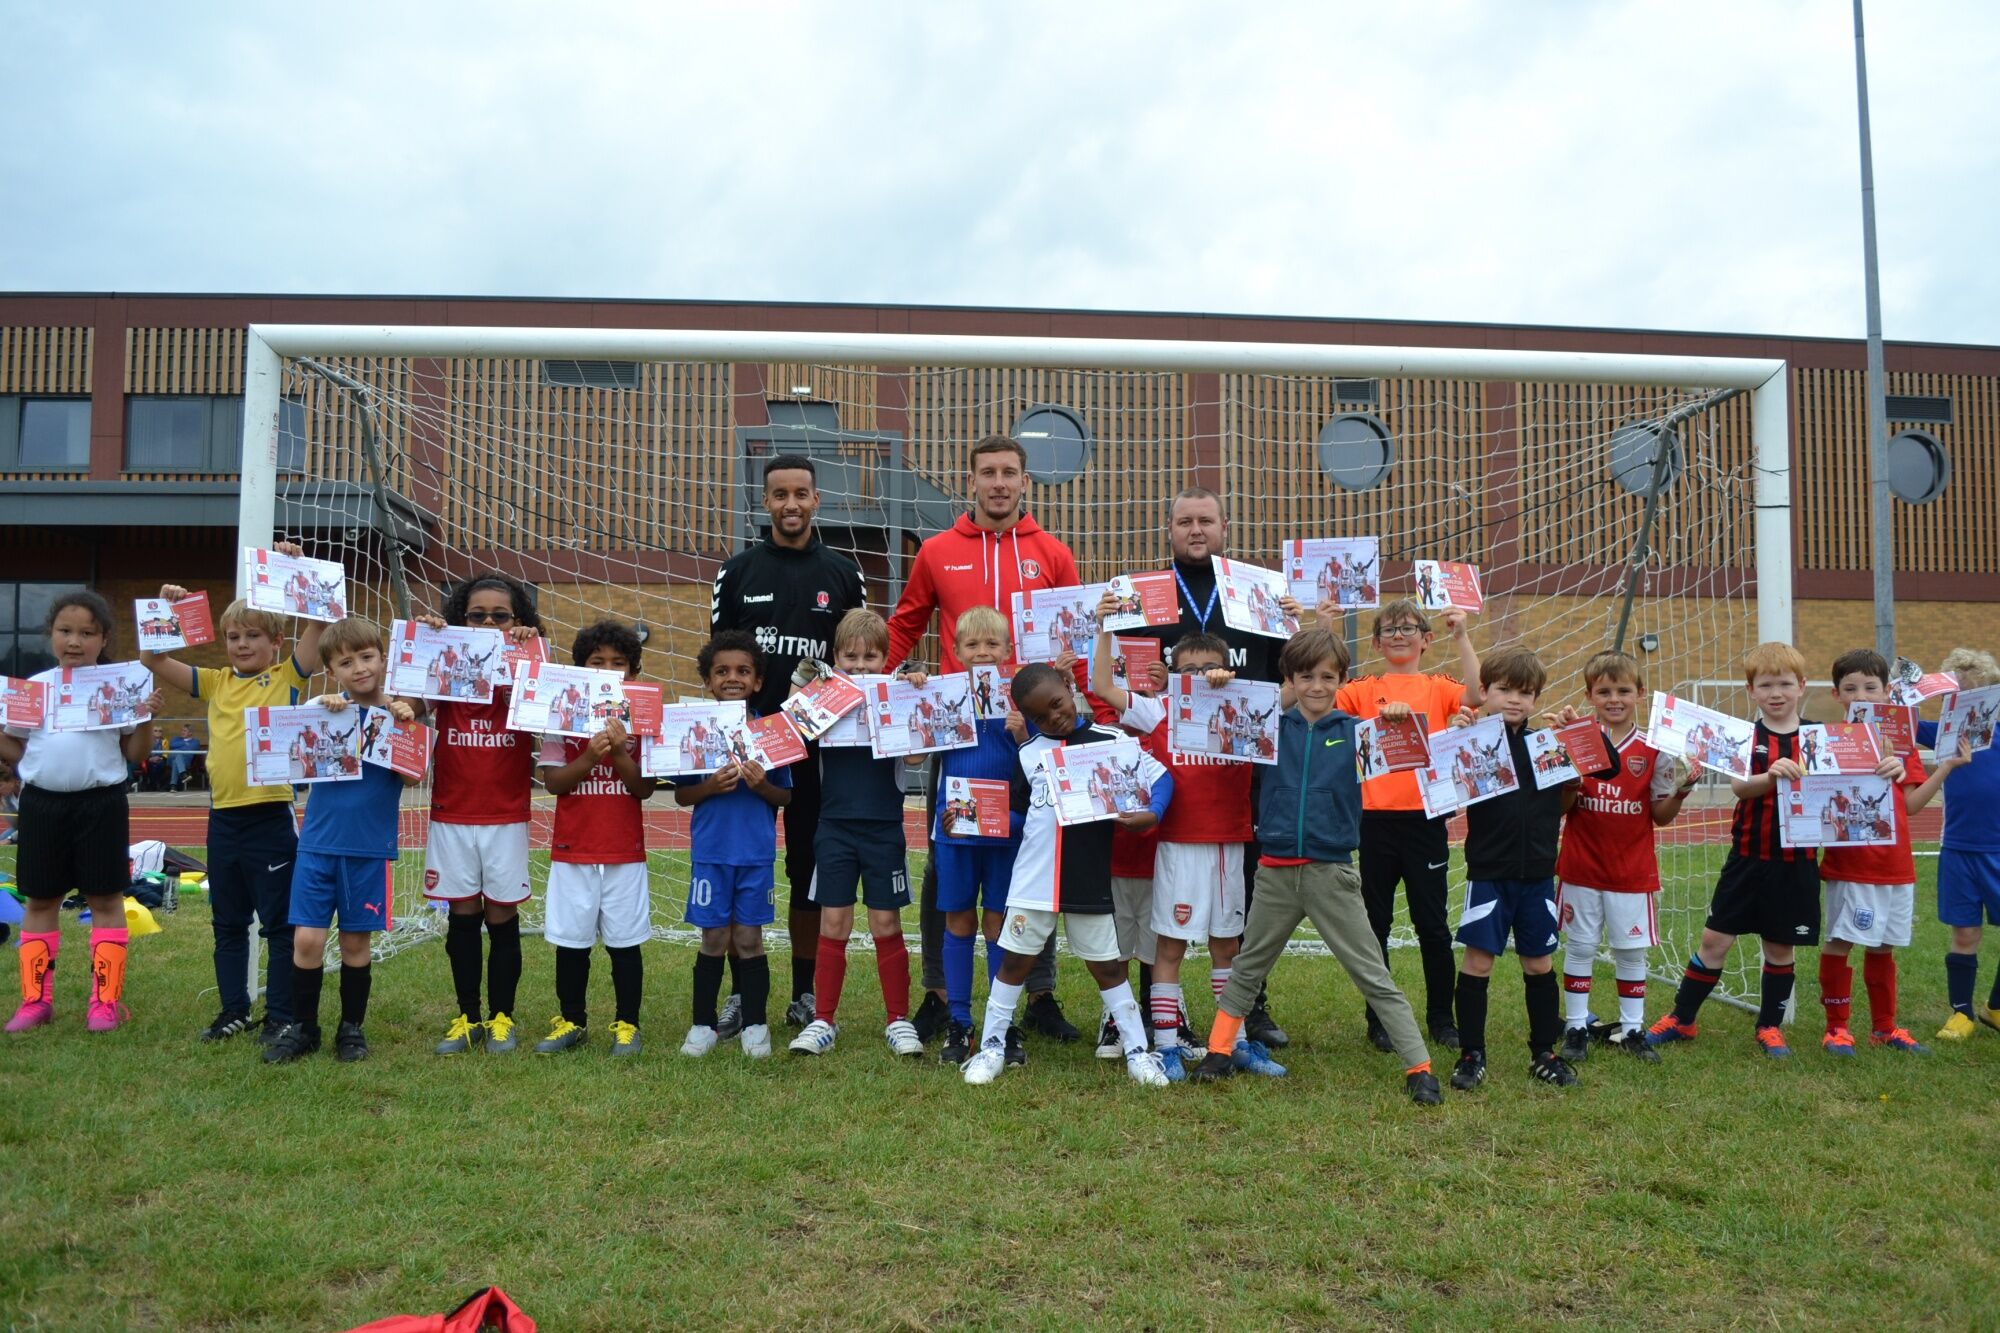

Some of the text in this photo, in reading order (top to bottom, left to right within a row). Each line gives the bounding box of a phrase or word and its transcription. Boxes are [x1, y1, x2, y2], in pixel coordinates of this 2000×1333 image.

[744, 592, 774, 604] hummel
[777, 635, 827, 660] ITRM
[470, 719, 492, 732] Fly
[448, 728, 516, 748] Emirates
[591, 764, 613, 779] Fly
[569, 778, 632, 796] mirate
[1598, 782, 1621, 797] Fly
[1577, 792, 1642, 816] Emirates
[691, 876, 712, 907] 10
[892, 874, 906, 894] 10
[98, 960, 106, 986] FLAIR
